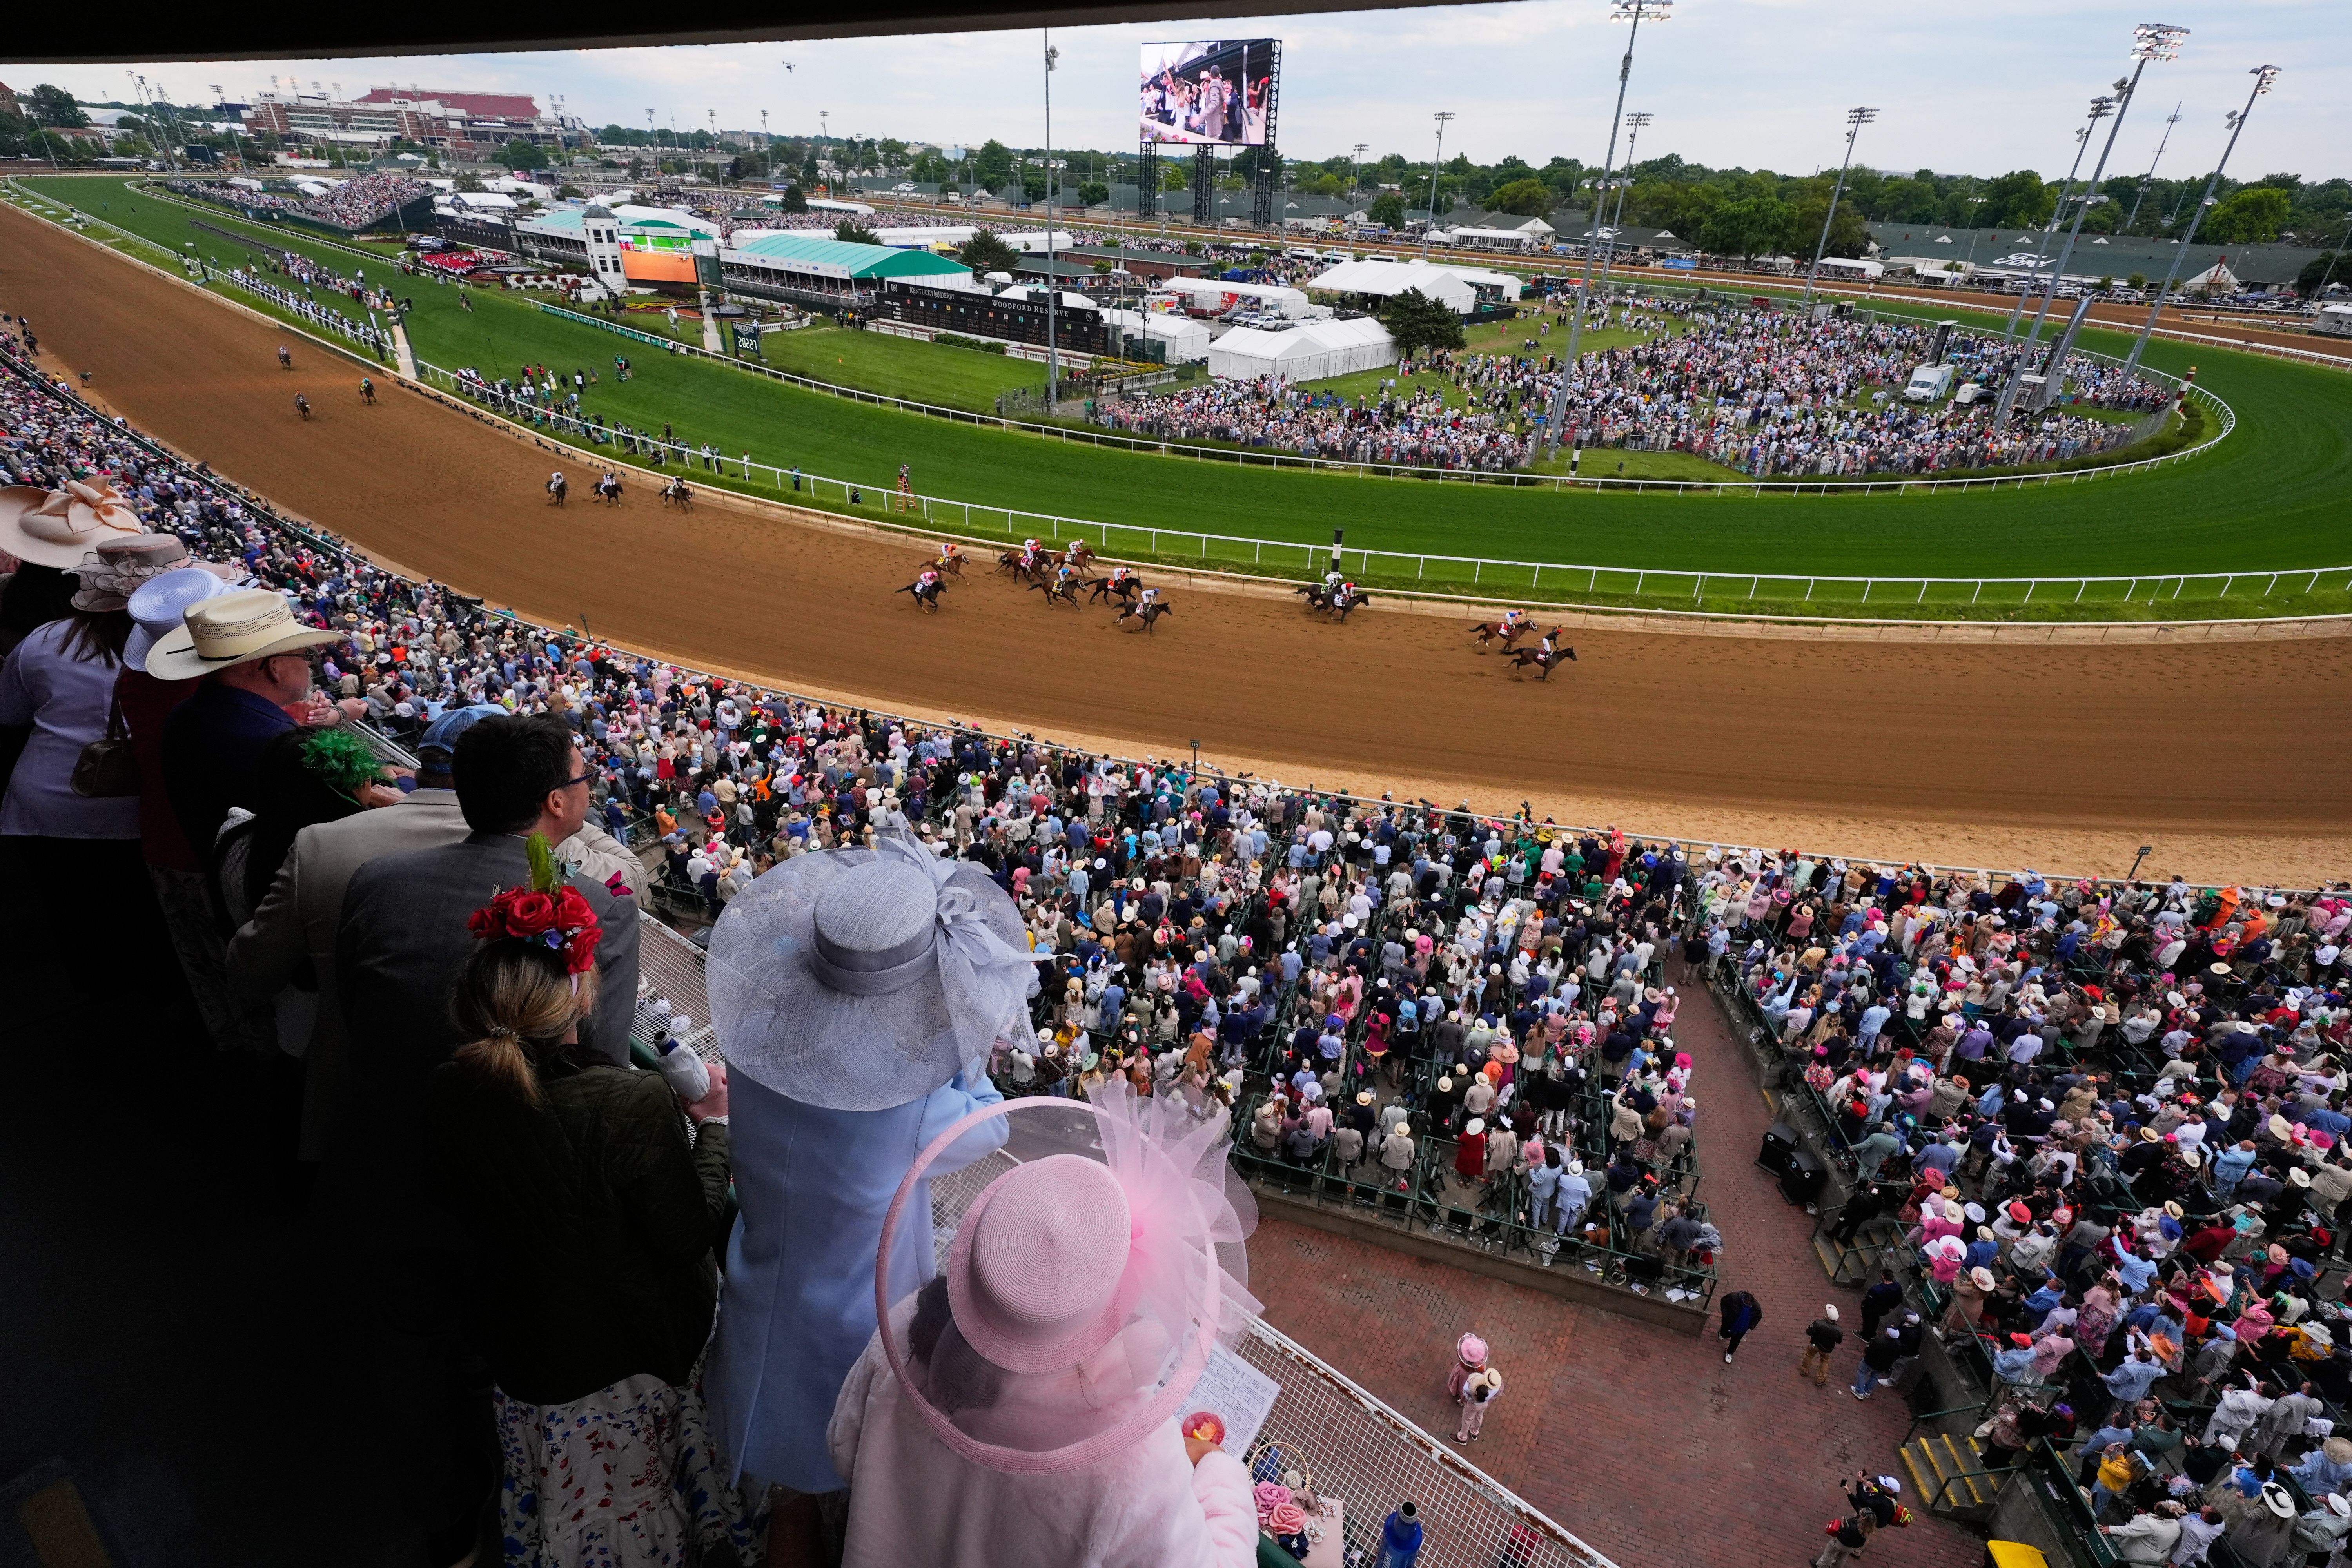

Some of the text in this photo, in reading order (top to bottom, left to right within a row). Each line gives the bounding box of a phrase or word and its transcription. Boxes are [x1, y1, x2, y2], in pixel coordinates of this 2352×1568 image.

[1584, 227, 1622, 239] Ford
[1993, 253, 2058, 267] Ford
[909, 287, 933, 296] KENTUCKY
[940, 291, 955, 300] DERBY
[991, 299, 1032, 312] WOODFORD
[1034, 305, 1069, 317] RESRVE
[733, 323, 754, 333] LONGINES
[1334, 594, 1343, 602] 22
